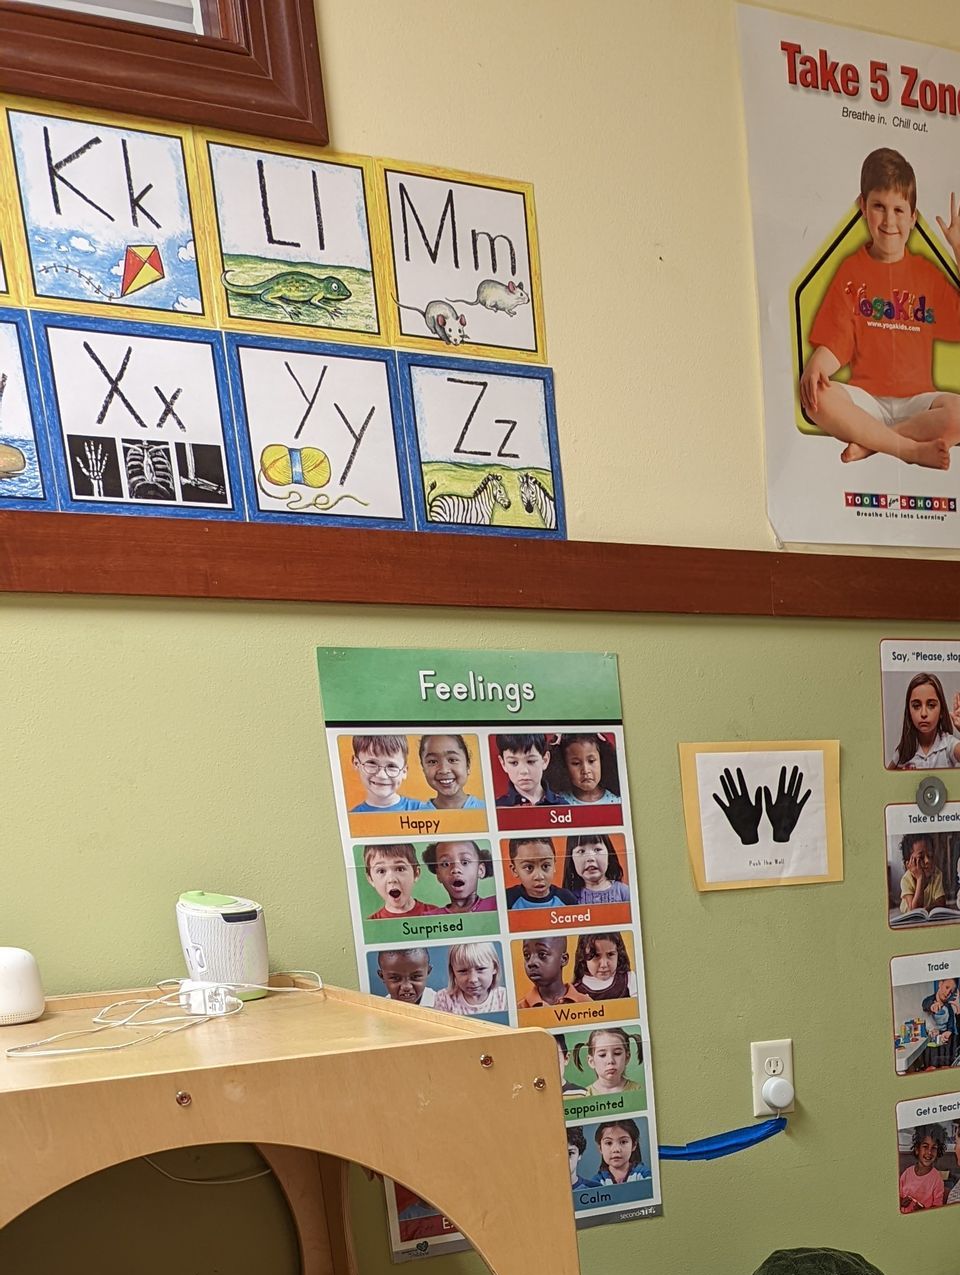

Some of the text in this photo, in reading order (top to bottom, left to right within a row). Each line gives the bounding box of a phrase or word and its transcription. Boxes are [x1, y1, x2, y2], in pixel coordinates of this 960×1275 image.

[780, 40, 860, 97] Take
[869, 59, 890, 102] 5
[841, 107, 928, 132] Breathe in. Chill out.
[844, 281, 936, 325] YogaKids
[867, 320, 920, 332] www.yogakids.com
[846, 495, 955, 510] TOOLS for SCHOOLS
[891, 651, 909, 662] Say,
[418, 669, 536, 713] Feelings
[550, 810, 572, 823] Sad
[908, 811, 960, 823] Take a break
[400, 816, 440, 834] Happy
[550, 909, 591, 924] Scared
[402, 919, 463, 938] Surprised
[927, 960, 949, 972] Trade
[554, 1005, 605, 1021] Worried
[564, 1096, 624, 1118] sappointed
[916, 1106, 931, 1117] Get
[932, 1106, 938, 1114] a
[580, 1191, 611, 1205] Calm
